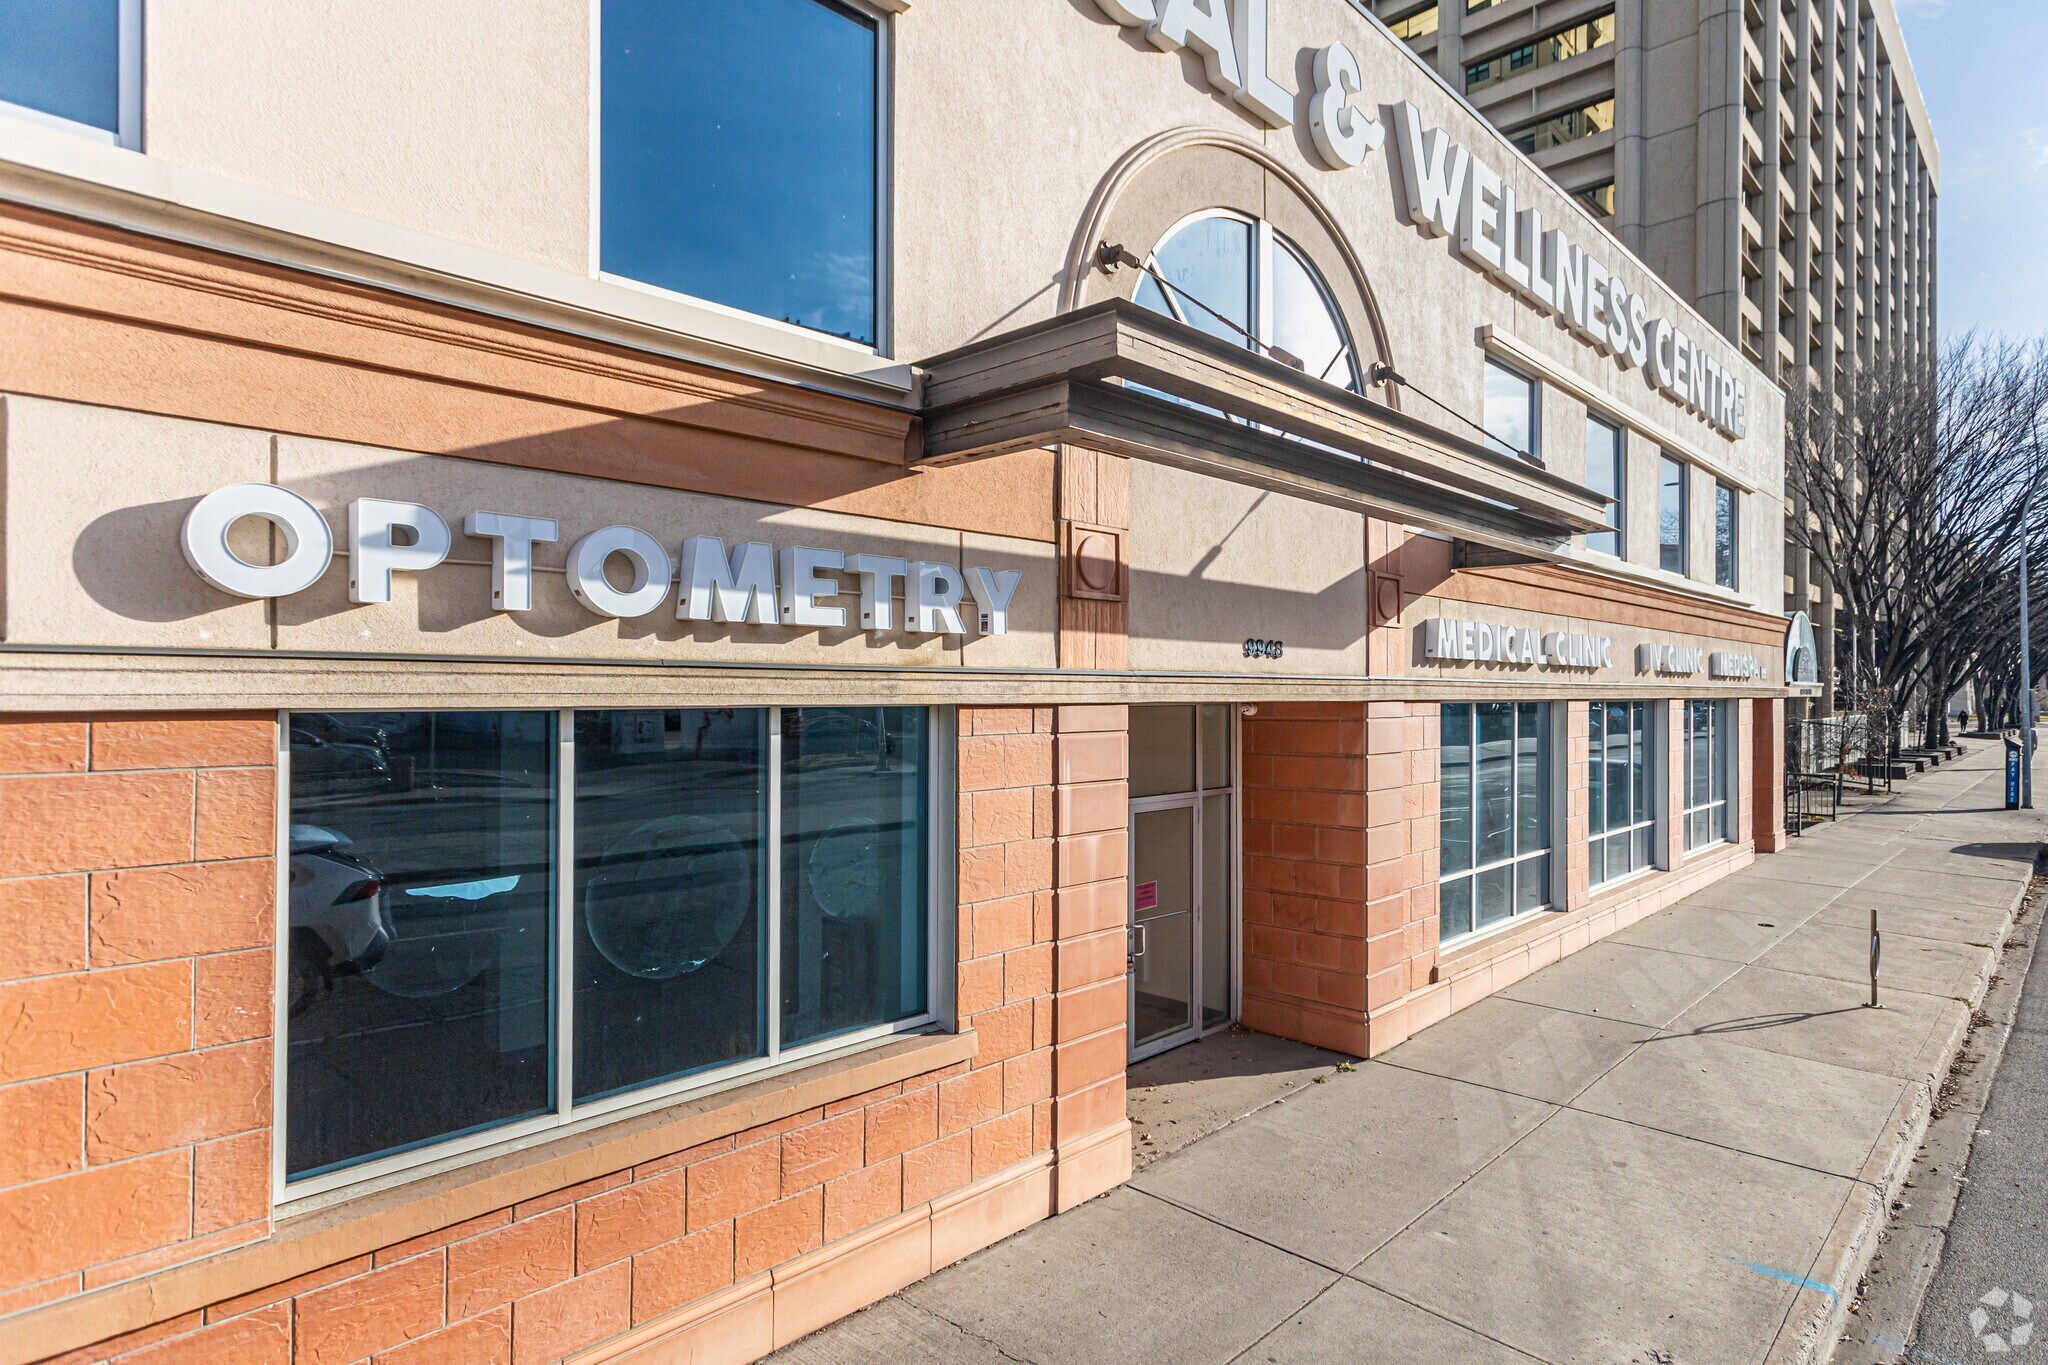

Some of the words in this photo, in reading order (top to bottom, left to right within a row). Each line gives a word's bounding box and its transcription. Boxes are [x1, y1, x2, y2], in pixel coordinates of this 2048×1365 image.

[1309, 41, 1385, 170] &
[1396, 99, 1649, 369] WELLNESS
[1650, 316, 1746, 441] CENTRE
[180, 481, 1022, 636] OPTOMETRY
[1430, 617, 1548, 665] MEDICAL
[1553, 631, 1614, 668] CLINIC
[1646, 642, 1663, 672] IV
[1667, 644, 1705, 673] CLINIC
[1717, 651, 1760, 678] MEDISPA
